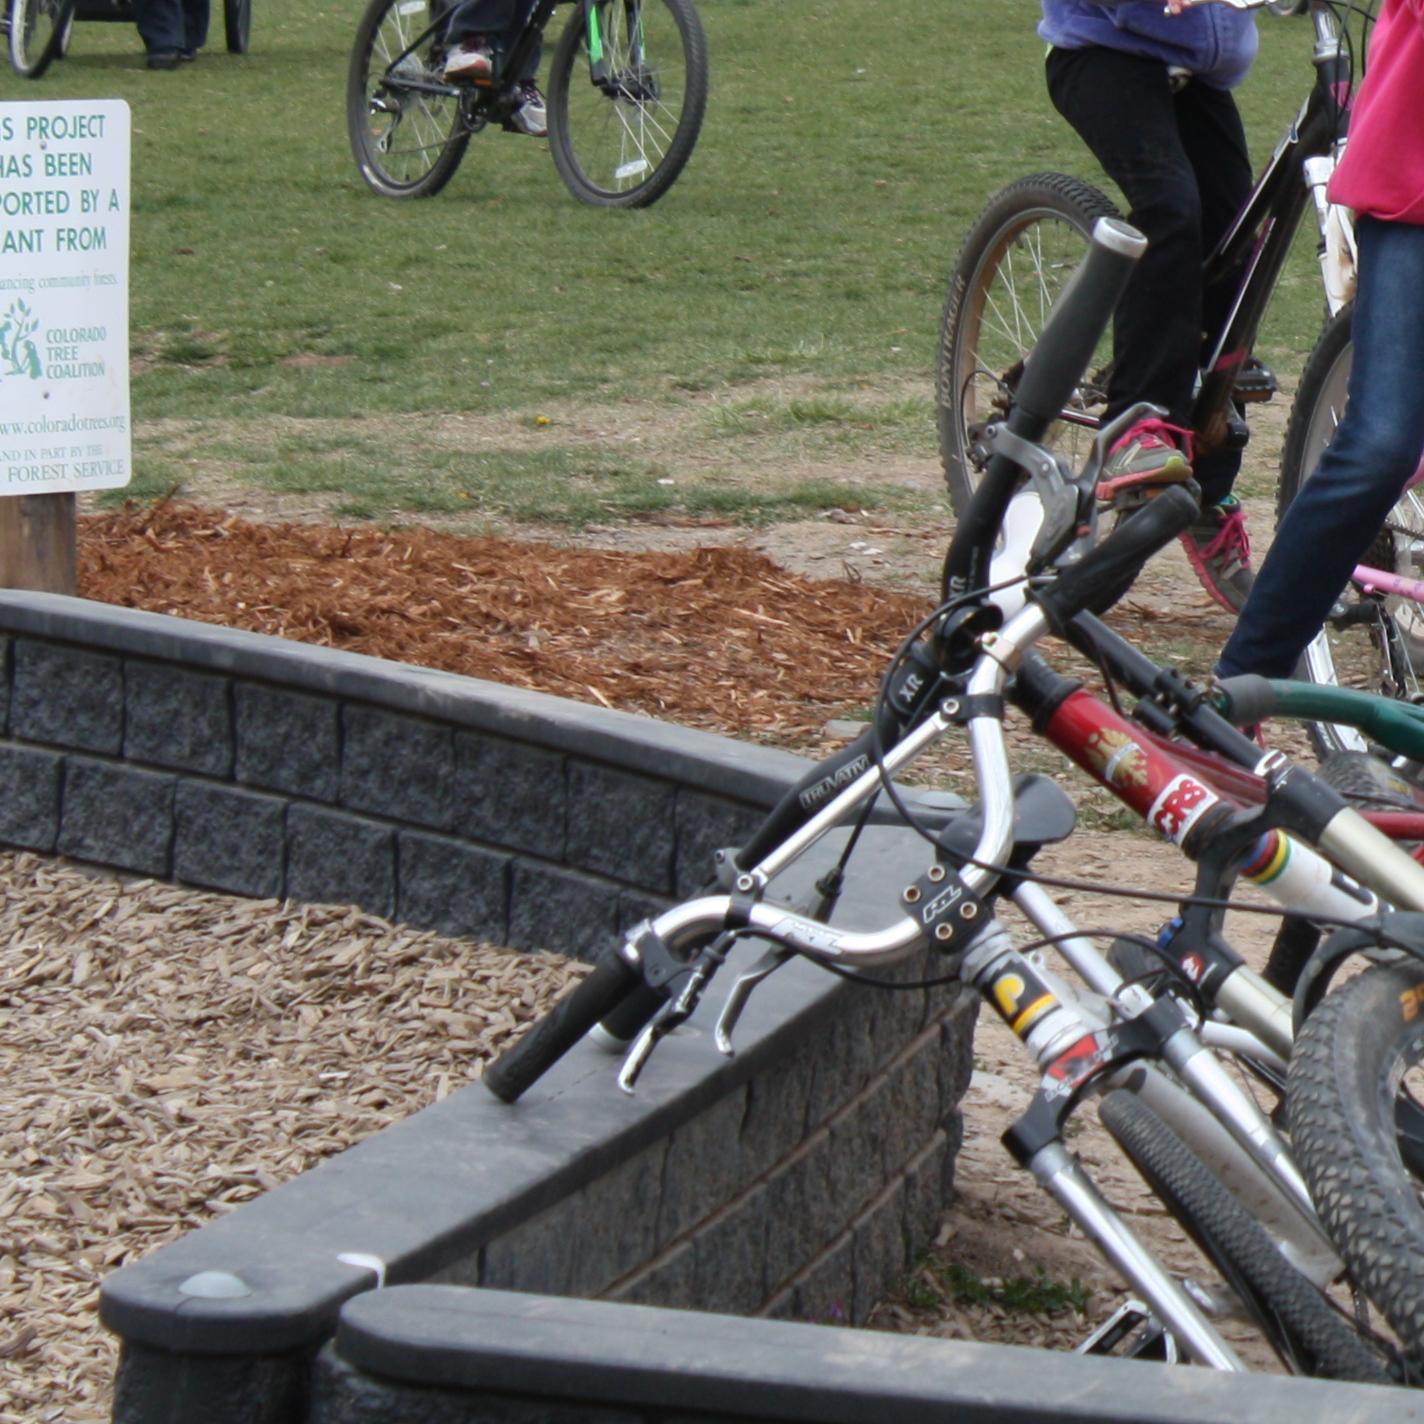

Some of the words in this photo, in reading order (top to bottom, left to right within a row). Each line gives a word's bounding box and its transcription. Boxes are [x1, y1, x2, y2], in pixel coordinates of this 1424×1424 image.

[0, 116, 14, 141] S
[26, 114, 106, 141] PROJECT
[44, 152, 92, 177] BEEN
[0, 190, 70, 216] ORTED
[80, 188, 100, 213] BY
[108, 187, 120, 212] A
[56, 226, 107, 252] FROM
[46, 326, 106, 344] COLORADO
[939, 274, 967, 410] BONTRAGER
[46, 346, 79, 361] TREE
[46, 362, 105, 379] COALITION
[40, 447, 67, 459] PART
[8, 464, 68, 482] FOREST
[73, 459, 125, 479] SERVICE
[899, 673, 924, 703] XR
[799, 753, 869, 809] TRUVATIV
